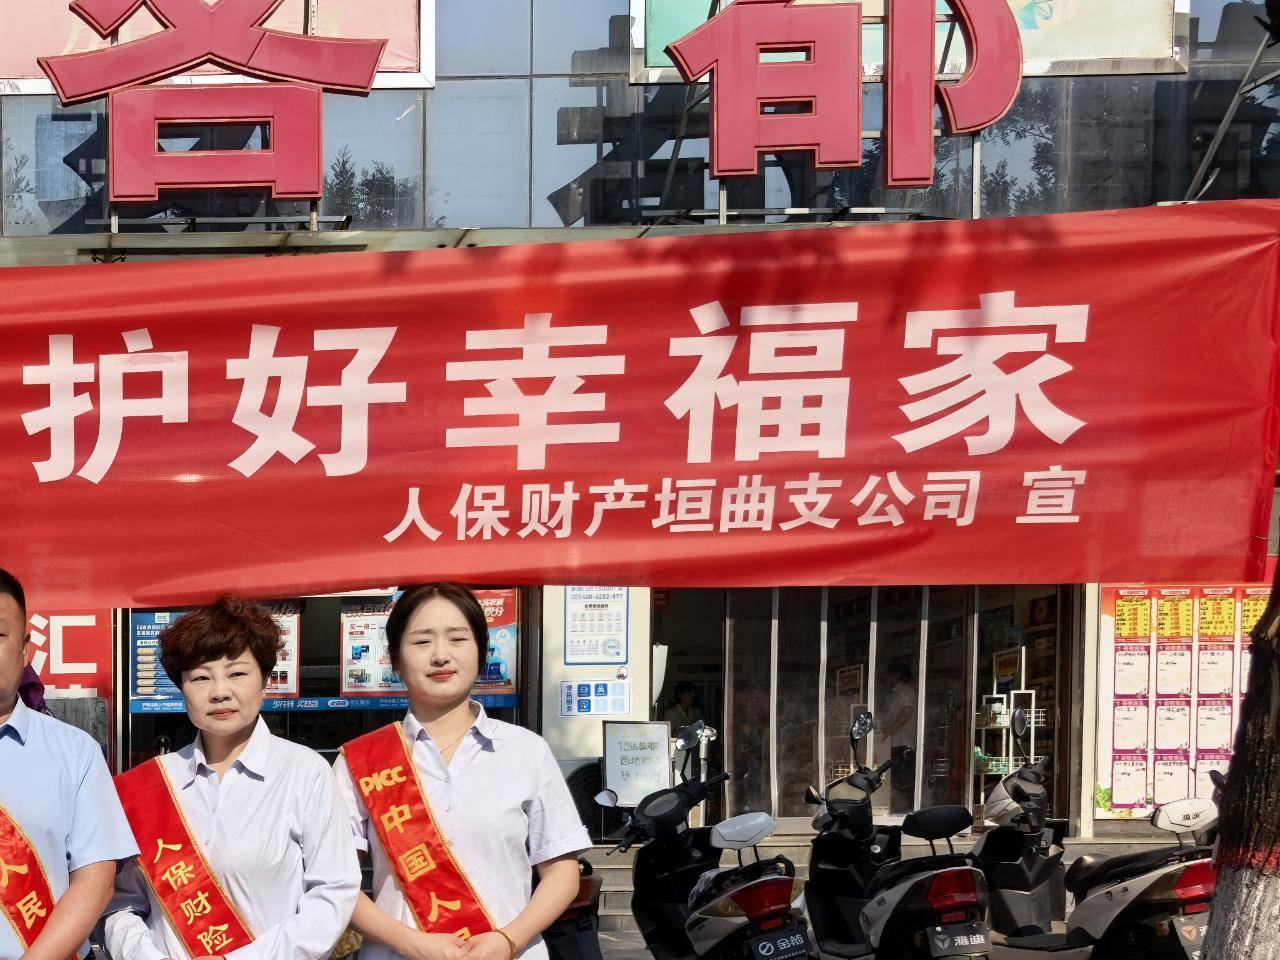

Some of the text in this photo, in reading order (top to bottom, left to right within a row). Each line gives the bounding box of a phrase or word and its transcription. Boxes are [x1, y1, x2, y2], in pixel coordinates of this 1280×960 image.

[21, 290, 1089, 486] 护好幸福家
[384, 465, 1086, 543] 人保财产垣曲支公司 宣
[359, 766, 407, 796] PICC
[953, 934, 986, 946] 雅迪
